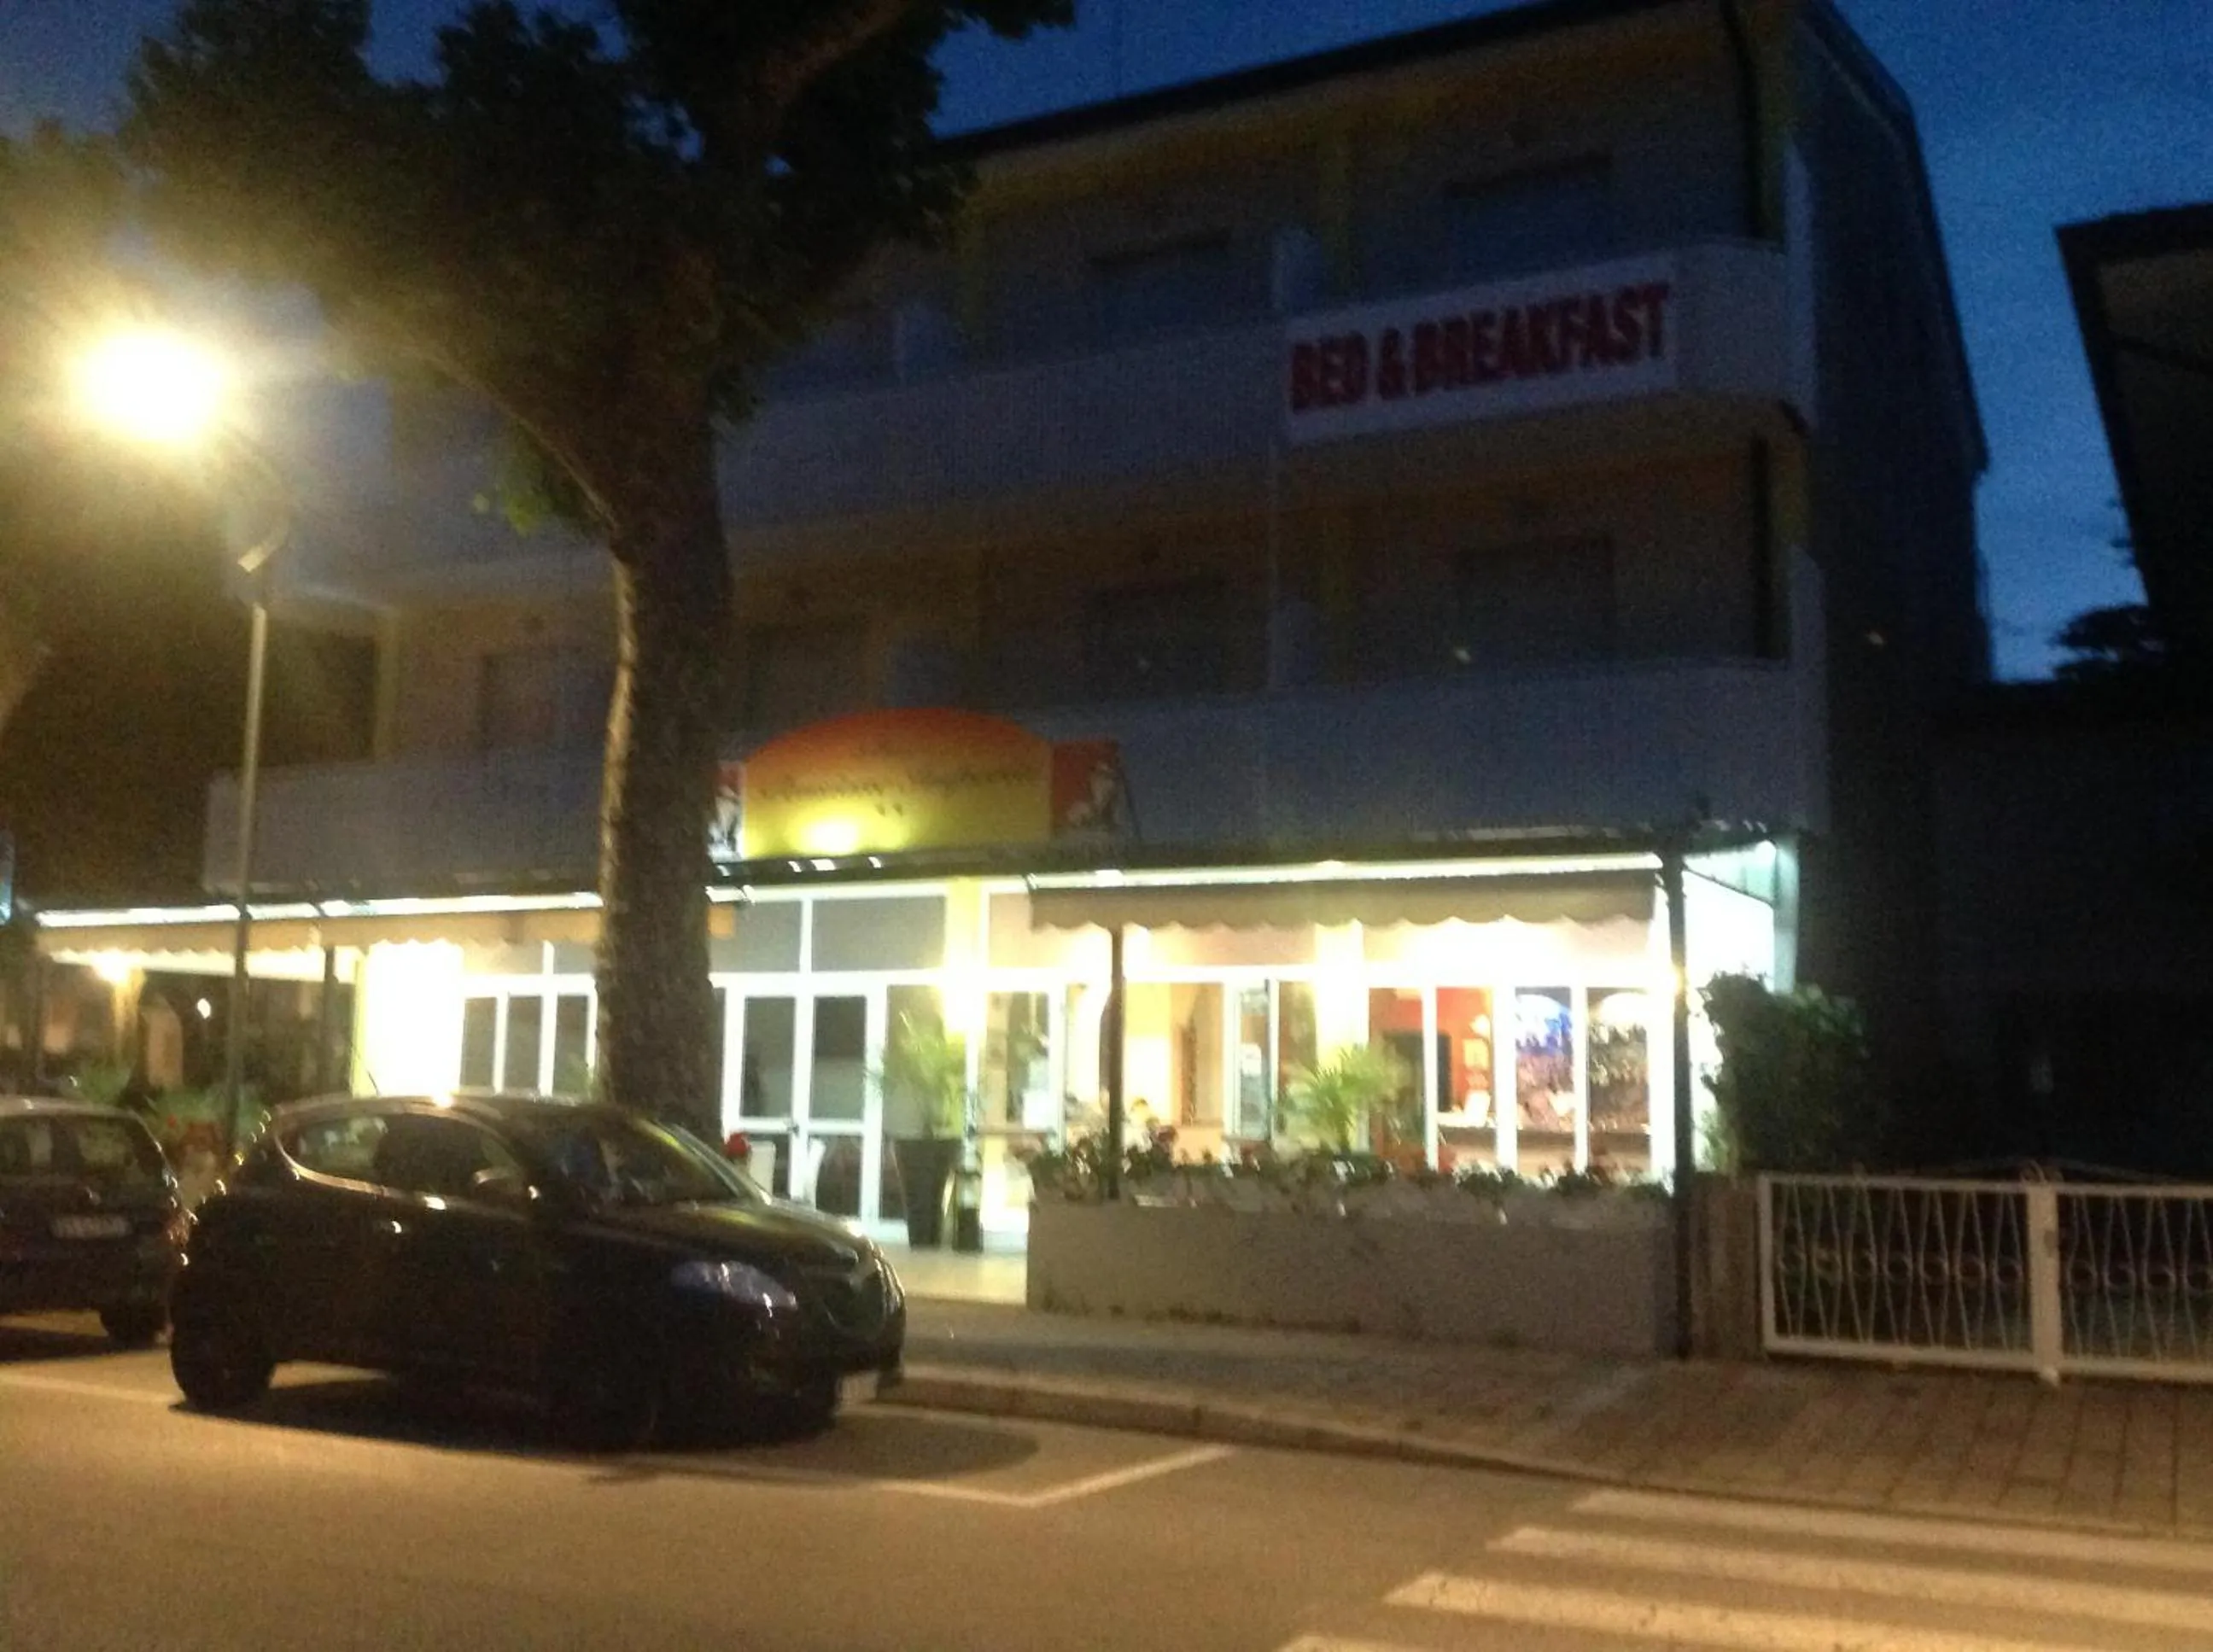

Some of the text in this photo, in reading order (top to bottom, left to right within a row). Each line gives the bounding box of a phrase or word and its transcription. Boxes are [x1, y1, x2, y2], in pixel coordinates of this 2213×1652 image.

[1292, 282, 1670, 410] BED & BREAKFAST
